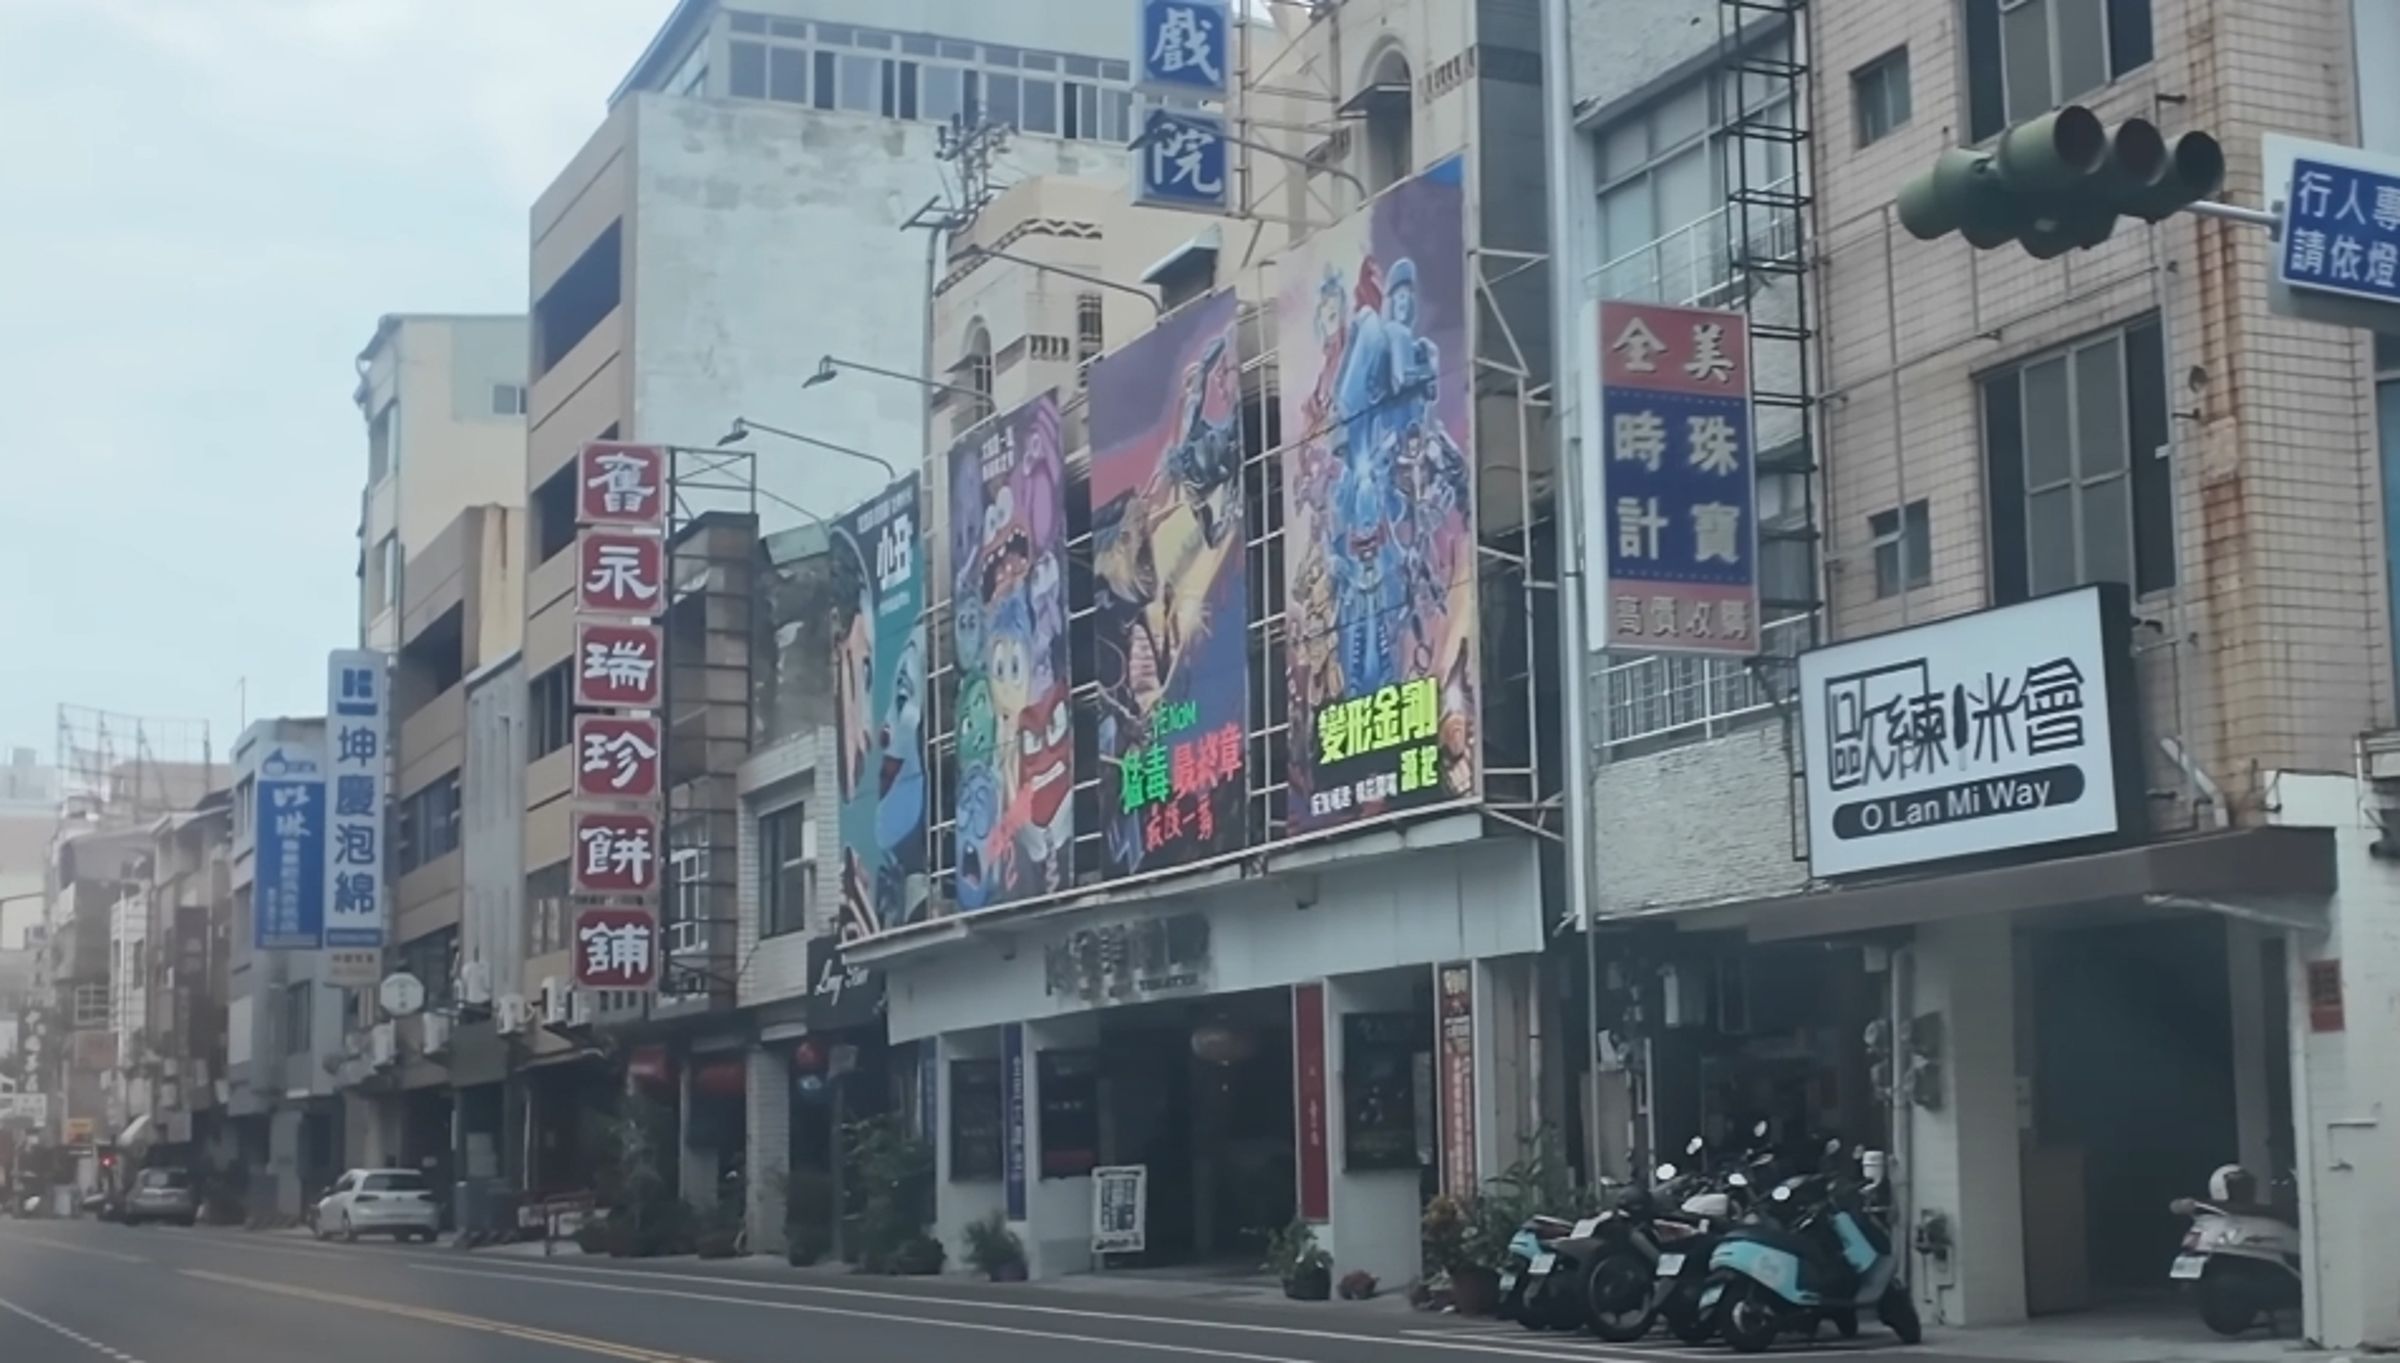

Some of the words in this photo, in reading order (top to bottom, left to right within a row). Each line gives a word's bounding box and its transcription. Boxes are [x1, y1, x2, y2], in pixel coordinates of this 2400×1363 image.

[1151, 7, 1223, 193] 戲院
[2291, 227, 2398, 287] 請依燈
[1318, 677, 1438, 764] 變形金剛
[334, 726, 377, 914] 坤慶泡綿
[1861, 804, 1882, 830] O
[1891, 800, 1940, 827] Lan
[1948, 786, 1979, 817] Mi
[1987, 780, 2050, 808] Way
